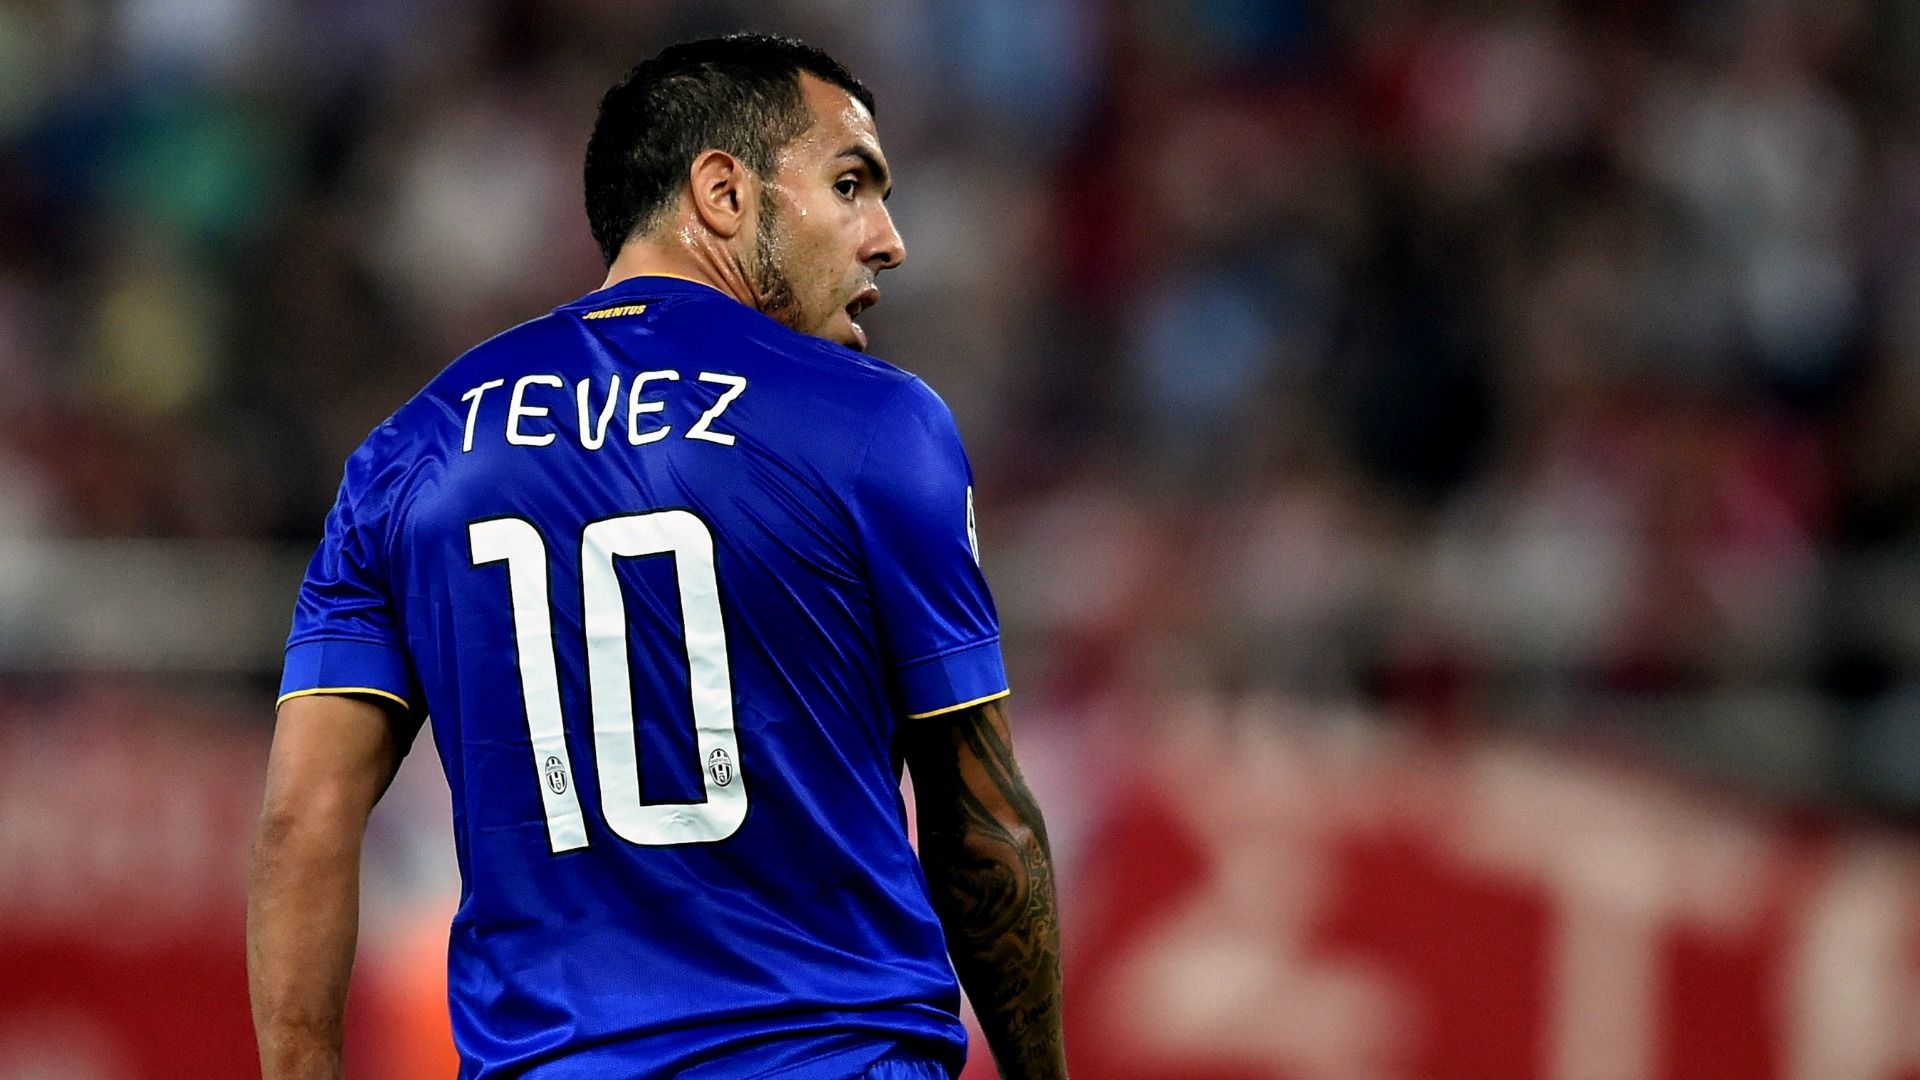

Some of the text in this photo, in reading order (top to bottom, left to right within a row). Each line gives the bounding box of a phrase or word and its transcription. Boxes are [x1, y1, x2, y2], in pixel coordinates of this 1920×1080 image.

[582, 305, 646, 319] JUVENTUS
[461, 369, 747, 452] TEVEZ
[468, 510, 748, 853] 10
